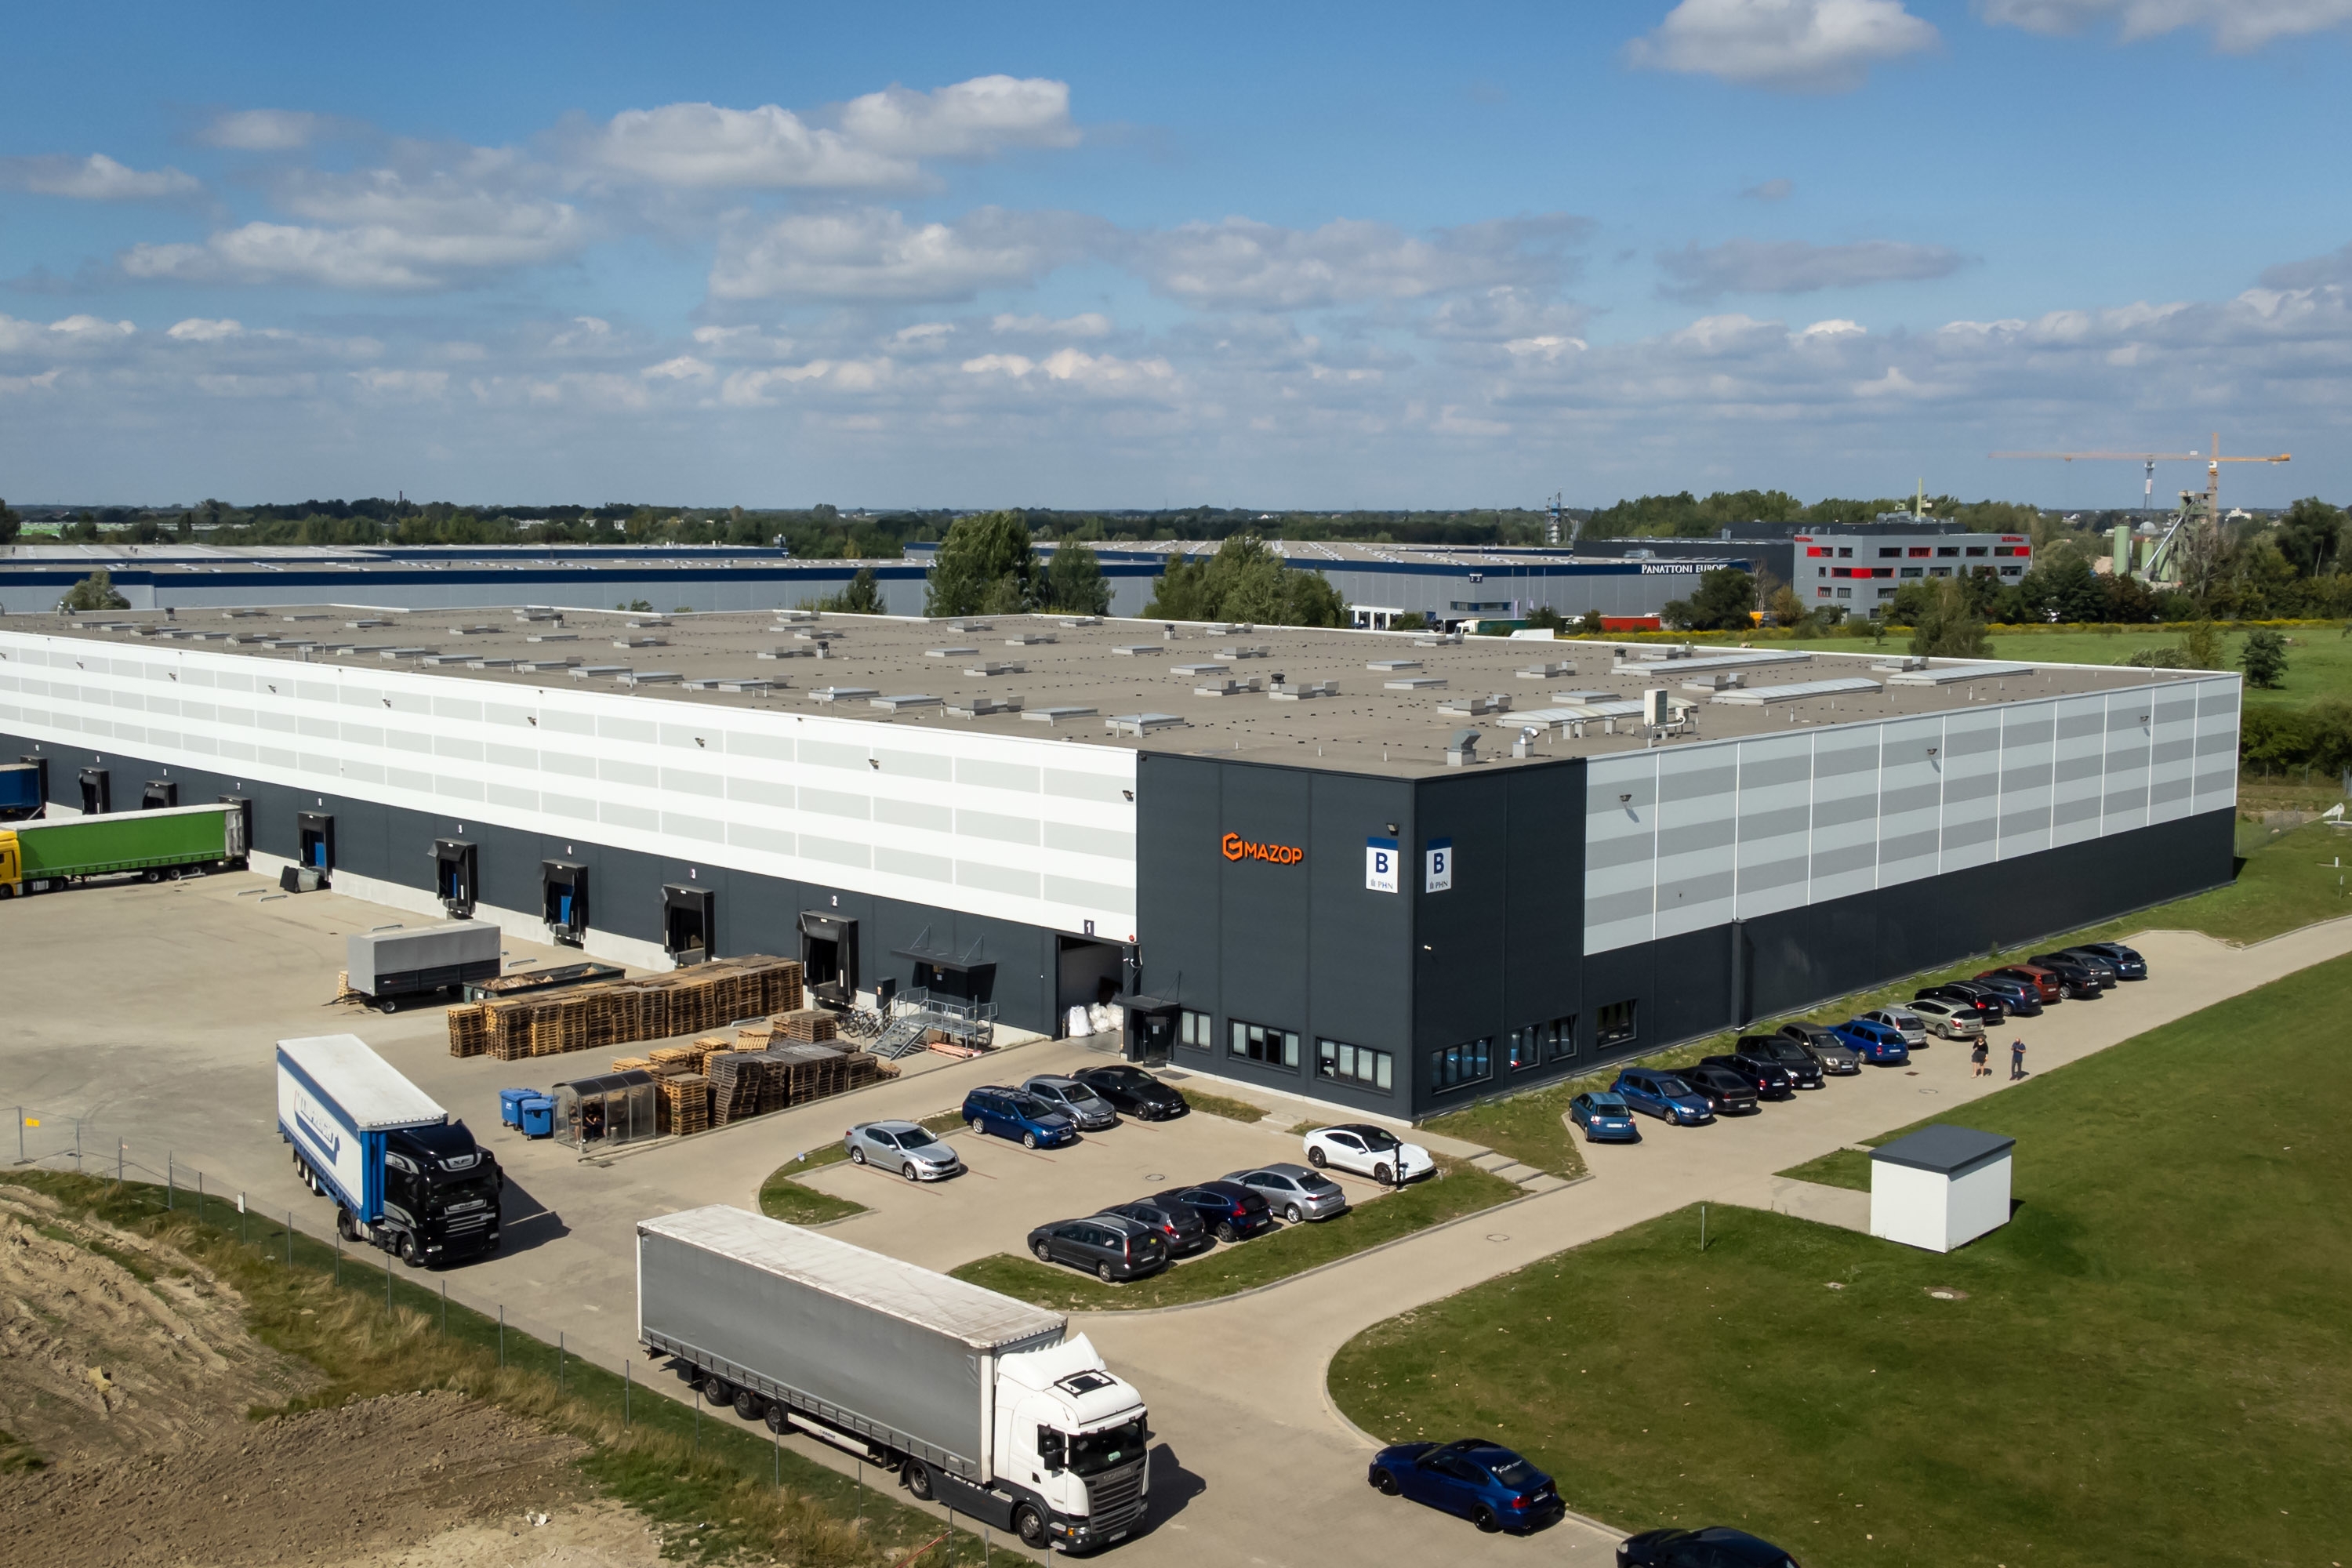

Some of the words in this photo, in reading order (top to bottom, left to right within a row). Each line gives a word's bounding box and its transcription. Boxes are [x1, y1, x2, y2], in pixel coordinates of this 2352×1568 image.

[1641, 564, 1693, 574] PANATTONI
[1695, 564, 1728, 573] EUROP
[567, 845, 572, 855] 4
[1375, 851, 1388, 873] B
[1433, 852, 1444, 874] B
[691, 868, 696, 880] 3
[1377, 880, 1393, 890] PHN
[1435, 880, 1449, 889] PHN
[832, 895, 838, 907] 2
[1086, 921, 1091, 934] 1
